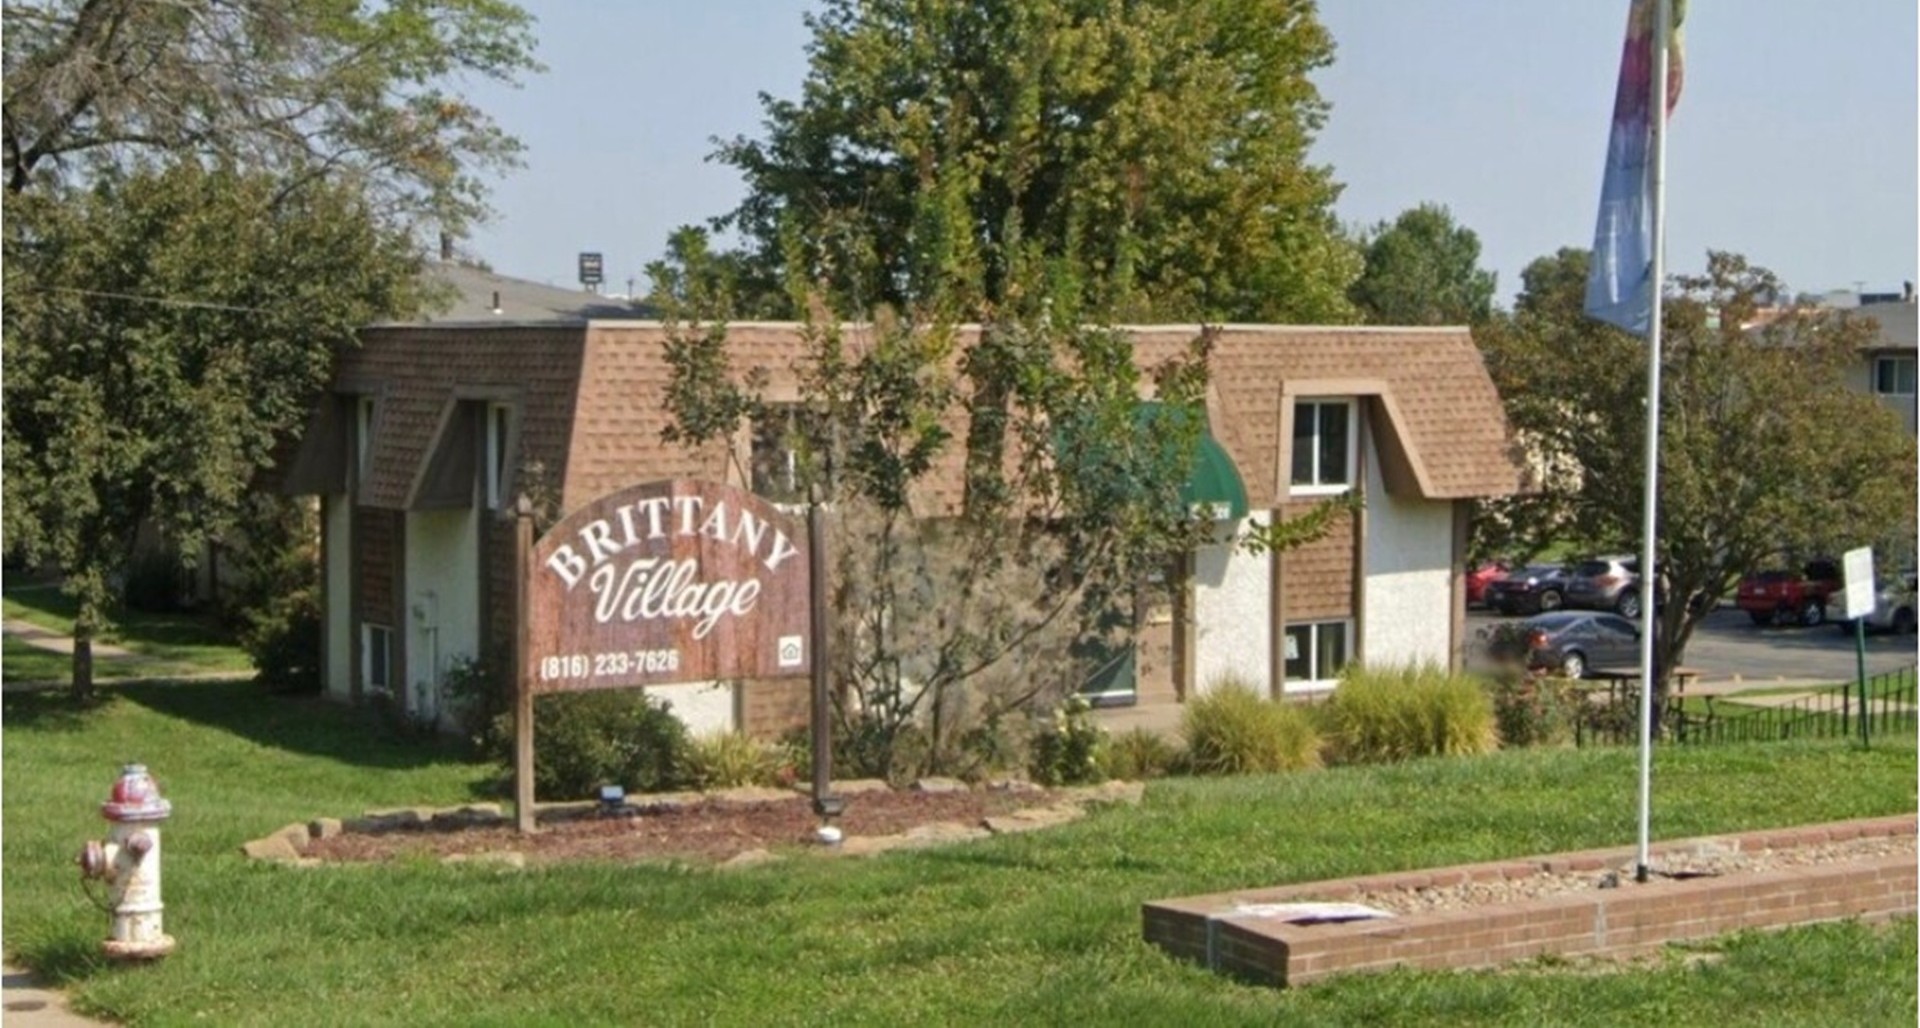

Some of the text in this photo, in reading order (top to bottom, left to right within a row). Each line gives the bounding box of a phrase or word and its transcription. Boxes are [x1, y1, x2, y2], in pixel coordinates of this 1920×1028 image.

[546, 496, 799, 590] BRITTANY
[590, 557, 760, 640] Village
[541, 649, 679, 680] (816) 233-7626
